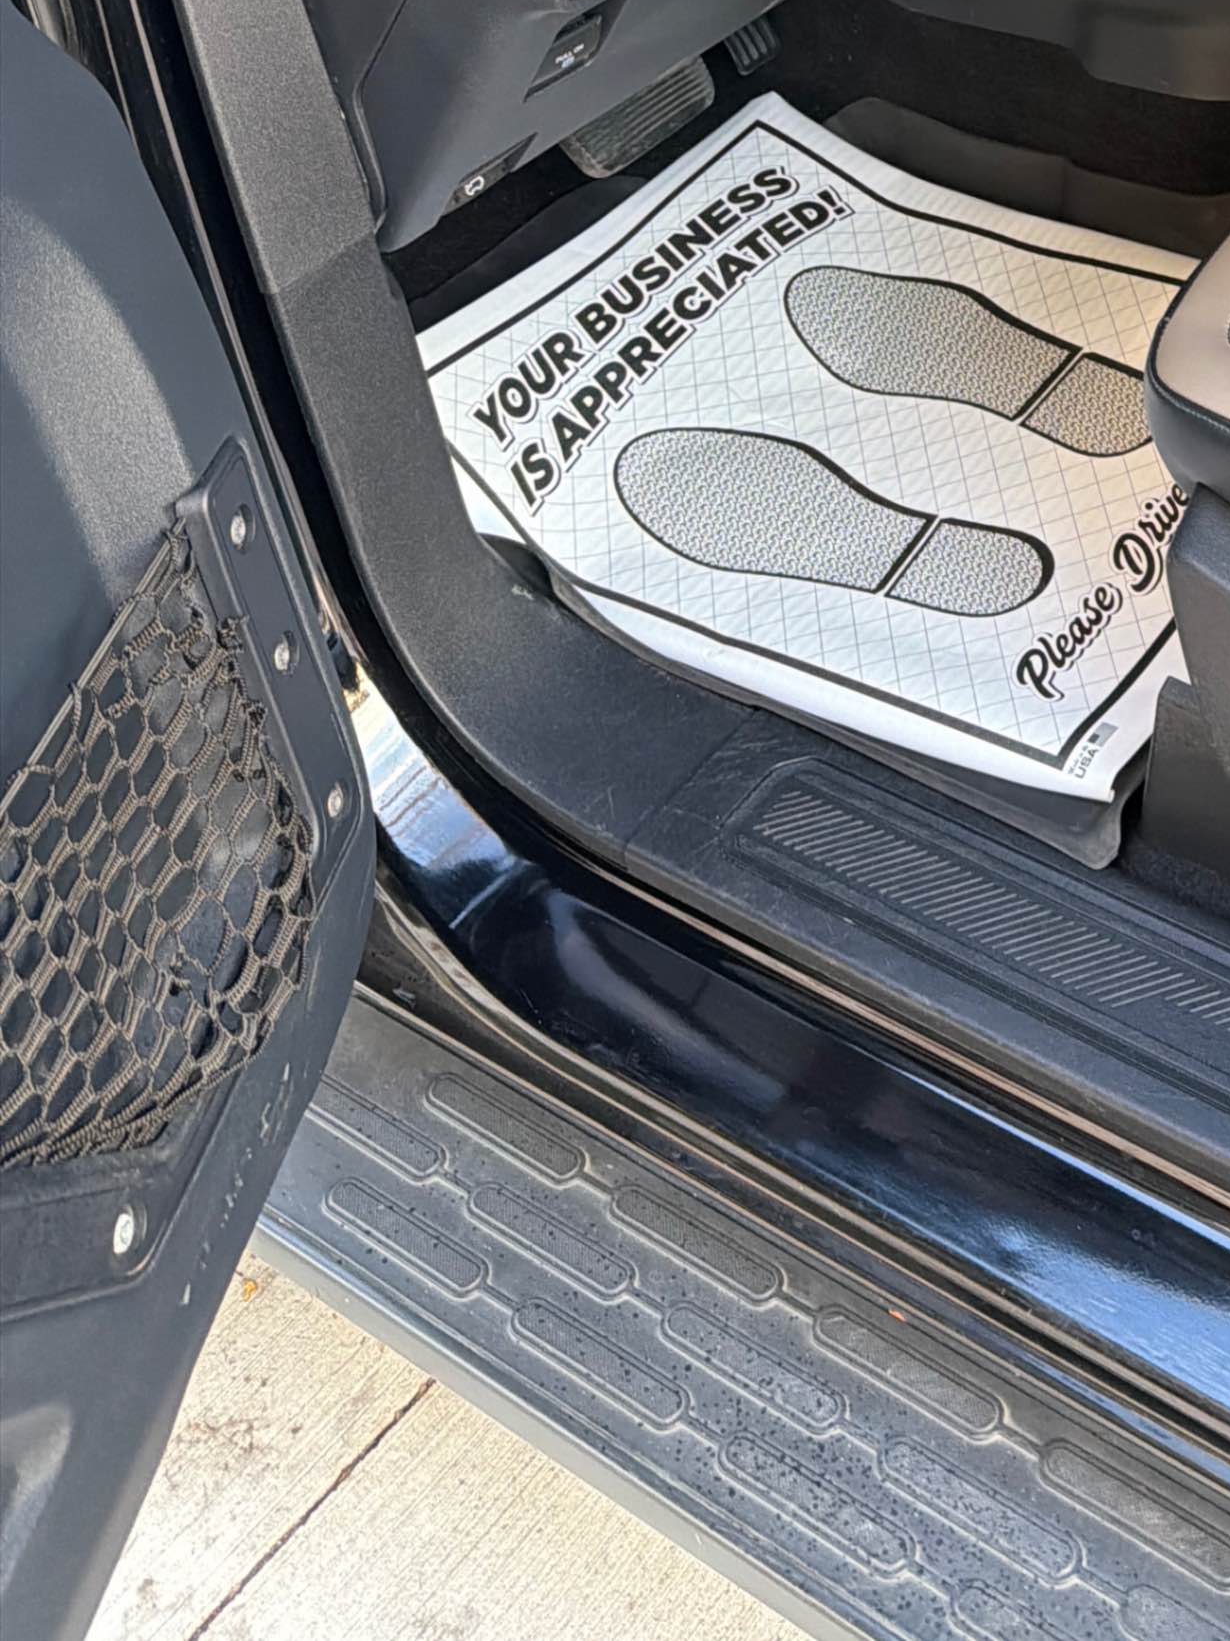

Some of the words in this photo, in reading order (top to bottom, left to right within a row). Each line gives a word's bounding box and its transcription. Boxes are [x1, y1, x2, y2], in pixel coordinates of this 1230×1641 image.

[474, 332, 585, 444] YOUR
[575, 167, 793, 344] BUSINESS
[510, 442, 555, 506] IS
[550, 190, 847, 462] APPRECIATED!
[1016, 584, 1117, 699] Please
[1113, 483, 1189, 593] Drive
[1074, 748, 1100, 780] USA
